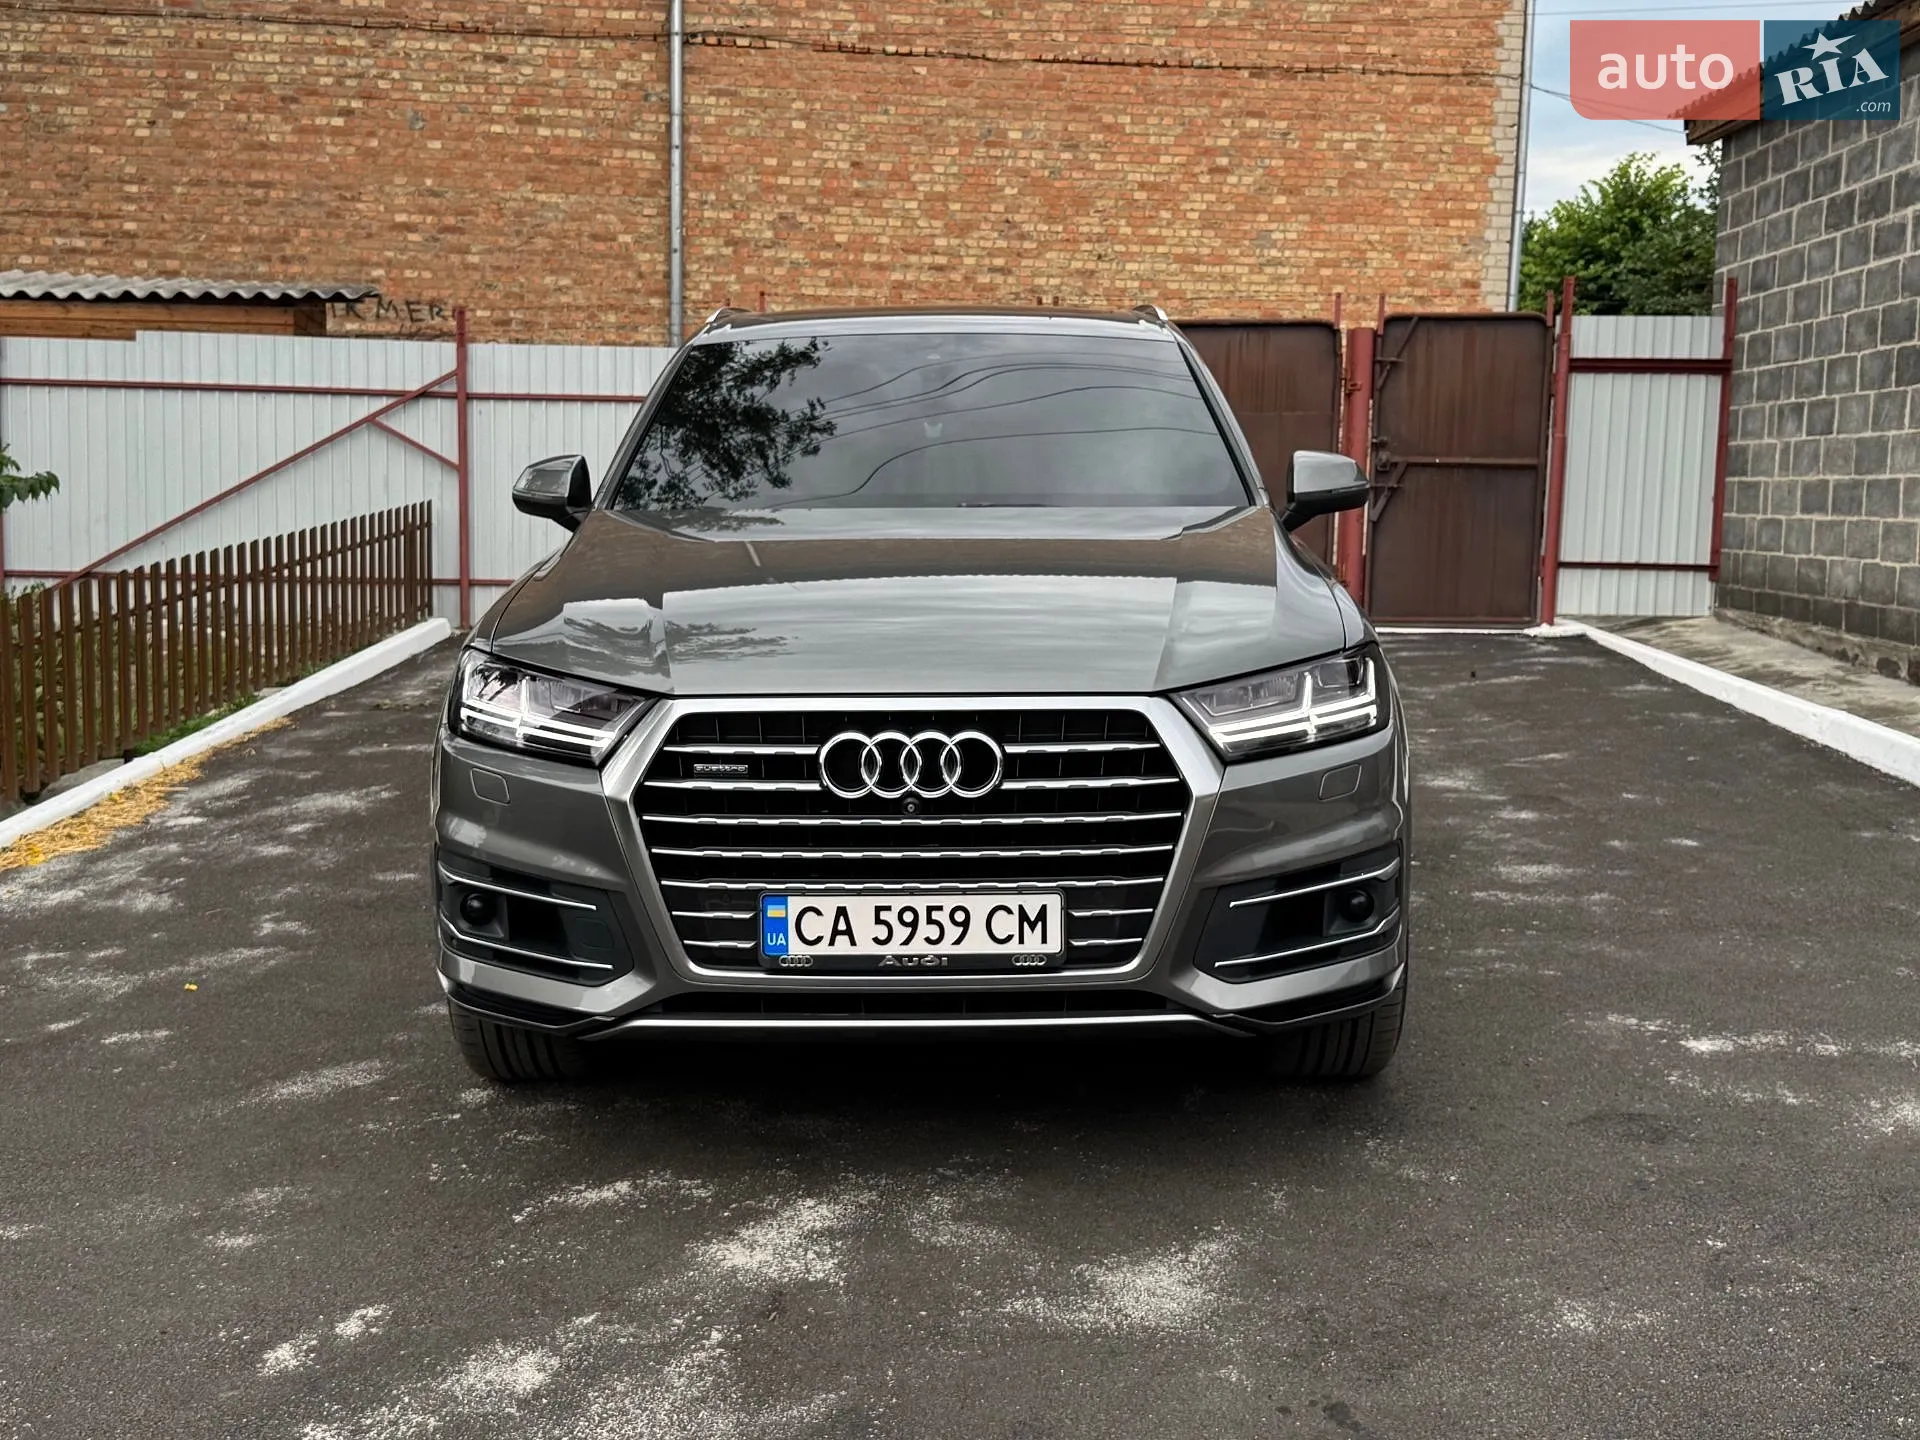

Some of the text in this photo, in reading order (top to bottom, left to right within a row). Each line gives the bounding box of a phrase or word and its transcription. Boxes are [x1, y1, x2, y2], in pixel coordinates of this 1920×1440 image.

[794, 903, 1048, 946] CA 5959 CM
[767, 932, 787, 946] UA
